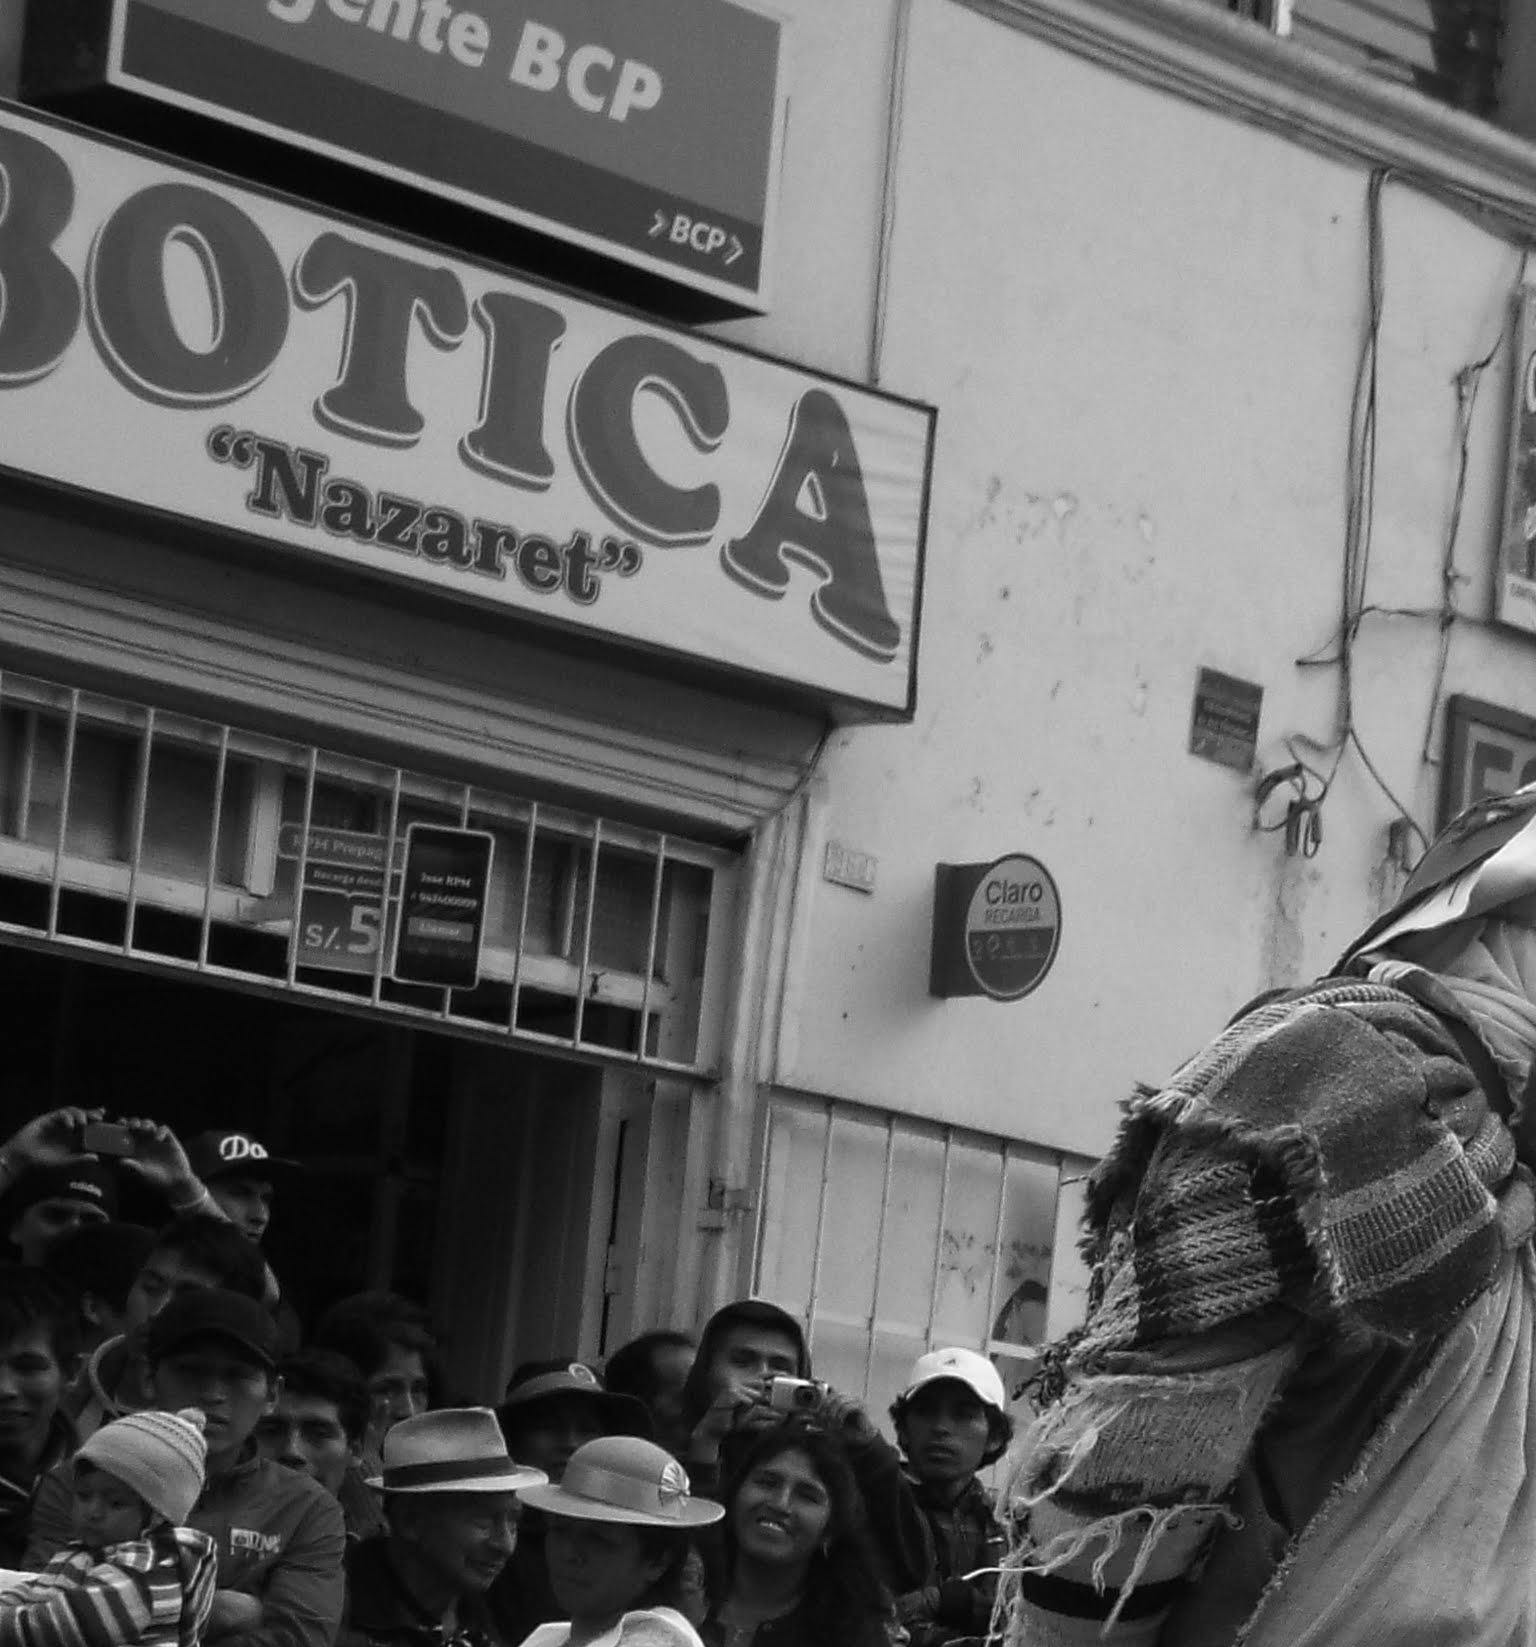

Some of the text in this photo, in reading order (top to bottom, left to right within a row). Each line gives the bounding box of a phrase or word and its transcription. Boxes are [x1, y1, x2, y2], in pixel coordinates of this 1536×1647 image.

[509, 21, 664, 125] BCP
[0, 124, 902, 664] BOTICA
[332, 838, 384, 861] Prepag
[984, 879, 1044, 905] Claro
[347, 903, 382, 955] 5
